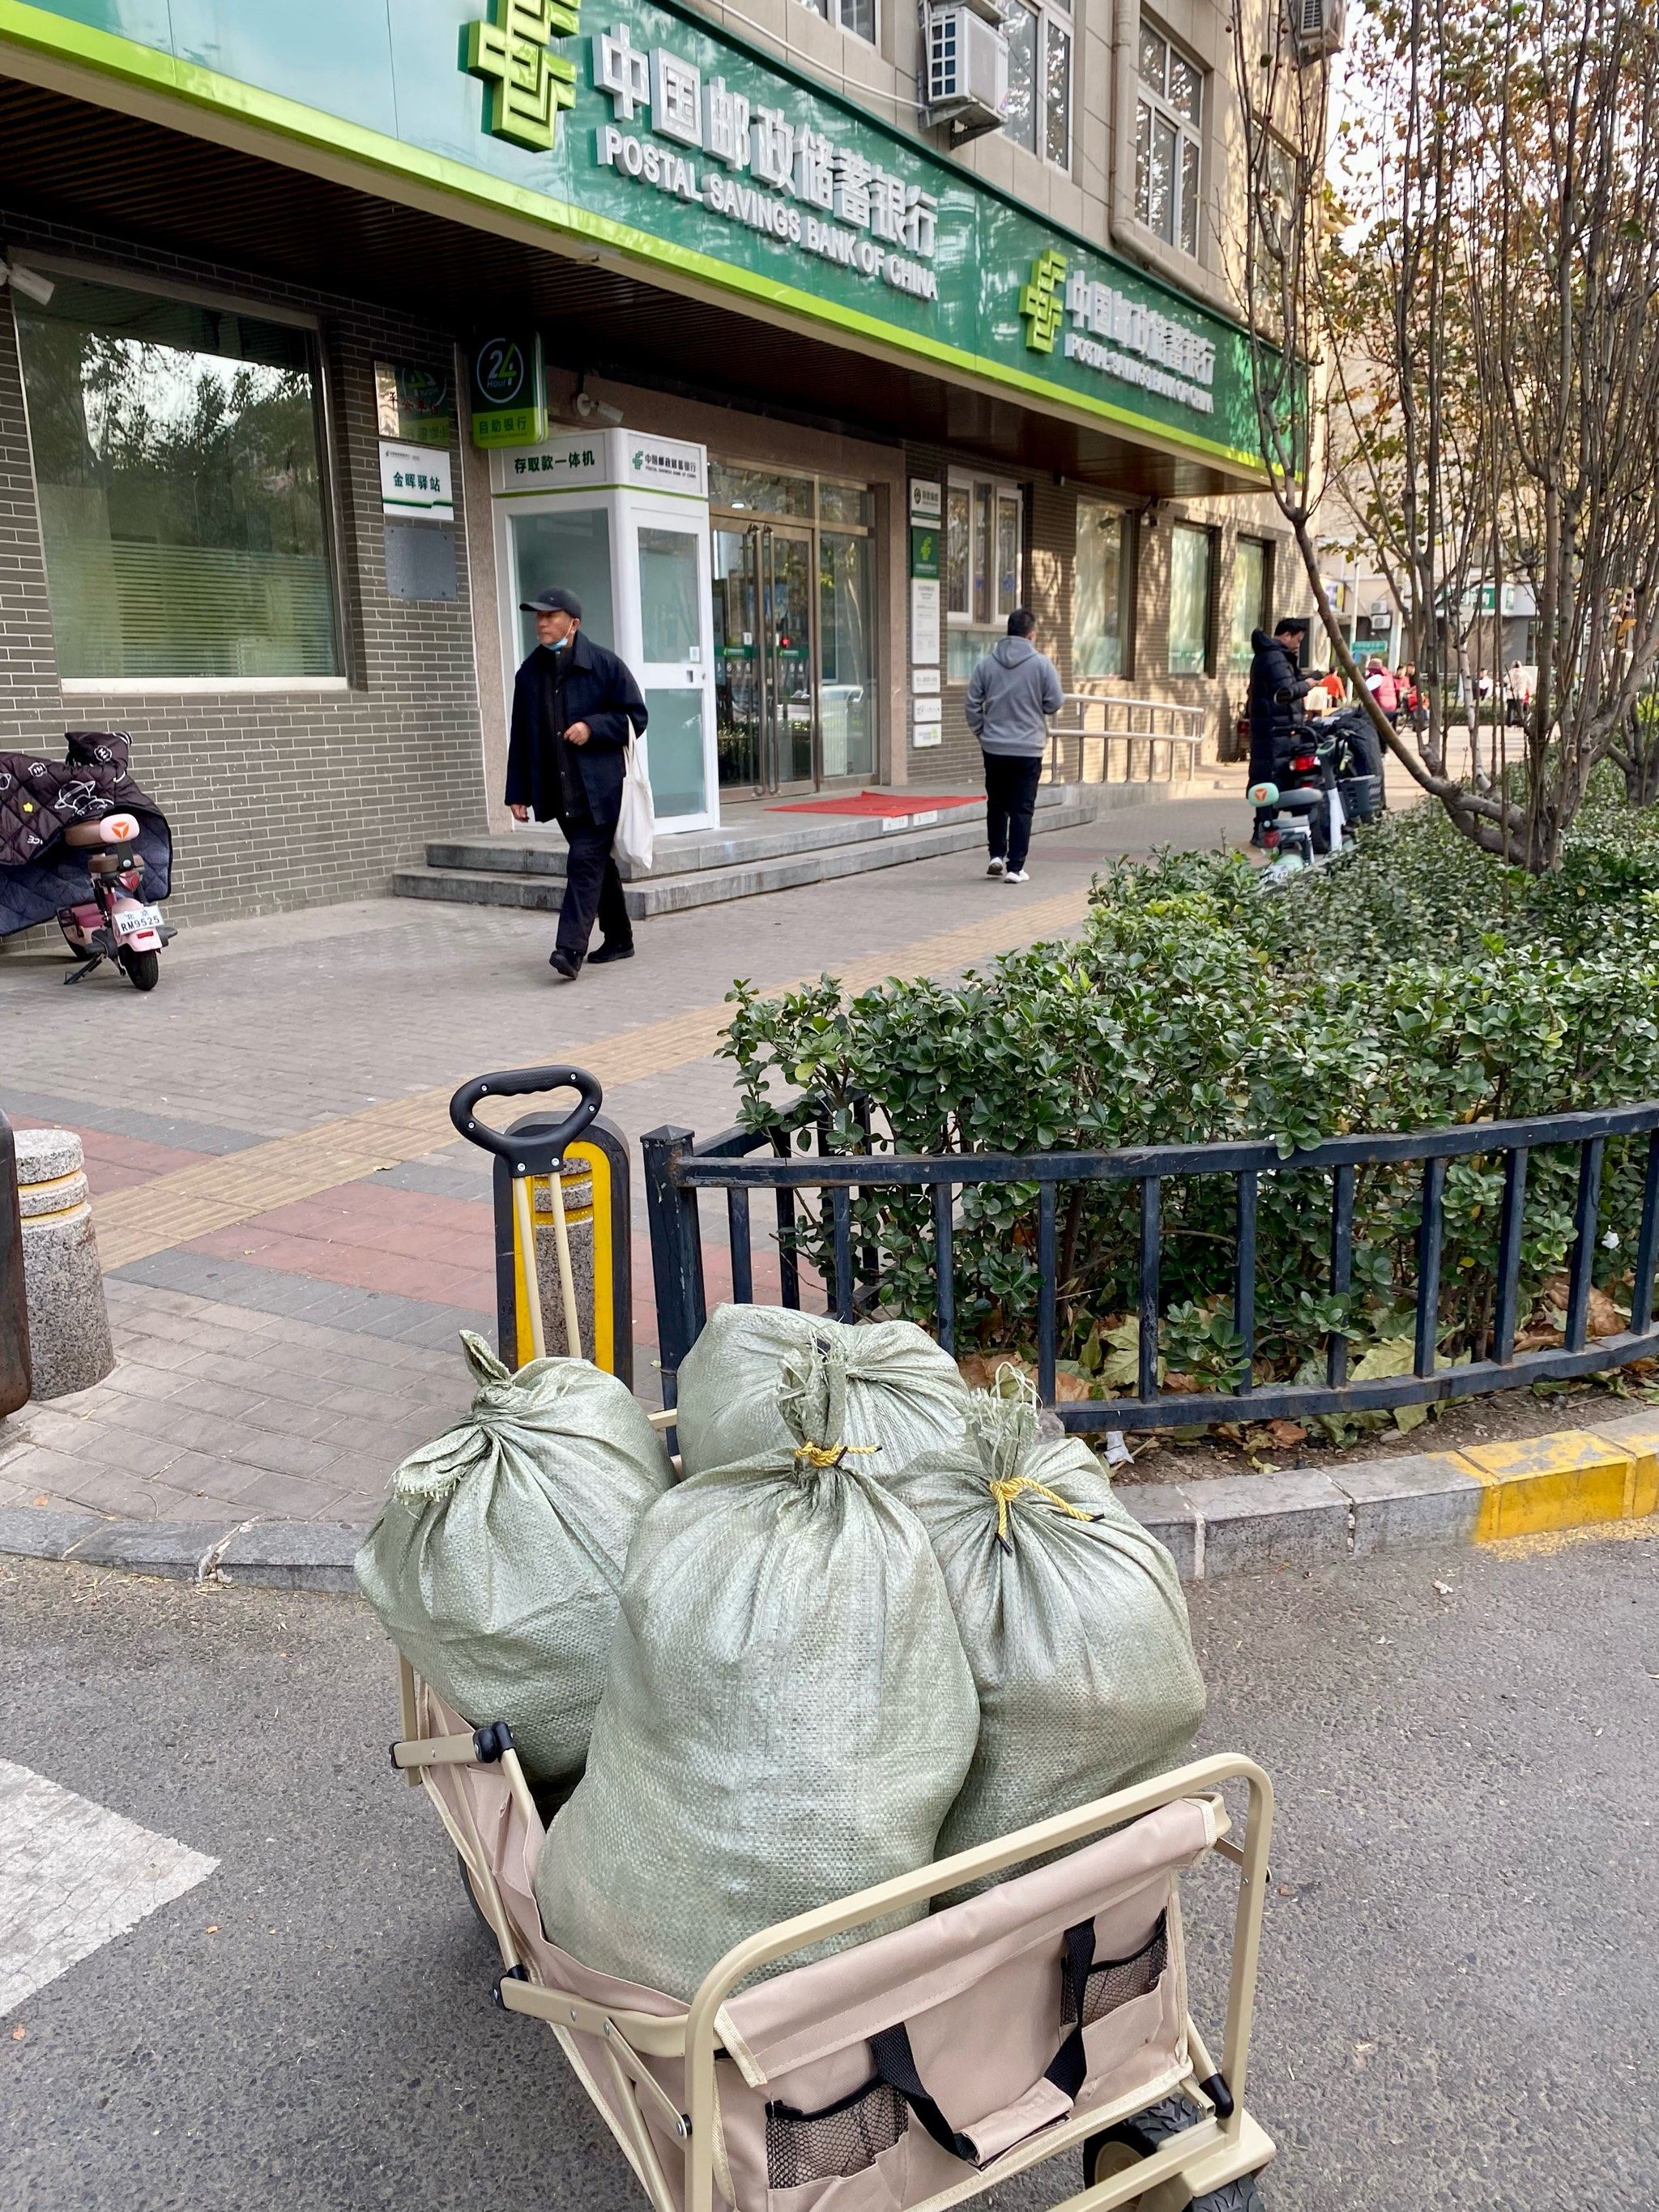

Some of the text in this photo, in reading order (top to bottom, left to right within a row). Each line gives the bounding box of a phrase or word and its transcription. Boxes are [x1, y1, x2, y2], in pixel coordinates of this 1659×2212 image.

[592, 23, 938, 258] 中国邮政储蓄银行
[596, 125, 938, 301] POSTAL SAVINGS BANK OF CHINA
[1065, 270, 1215, 385] 中国邮政储蓄银行
[488, 344, 517, 386] 24
[1064, 333, 1111, 372] POSTAL
[487, 378, 507, 388] Hour
[479, 416, 527, 435] 自助银行
[514, 451, 595, 473] 存取款一体机
[121, 916, 160, 932] RM9525
